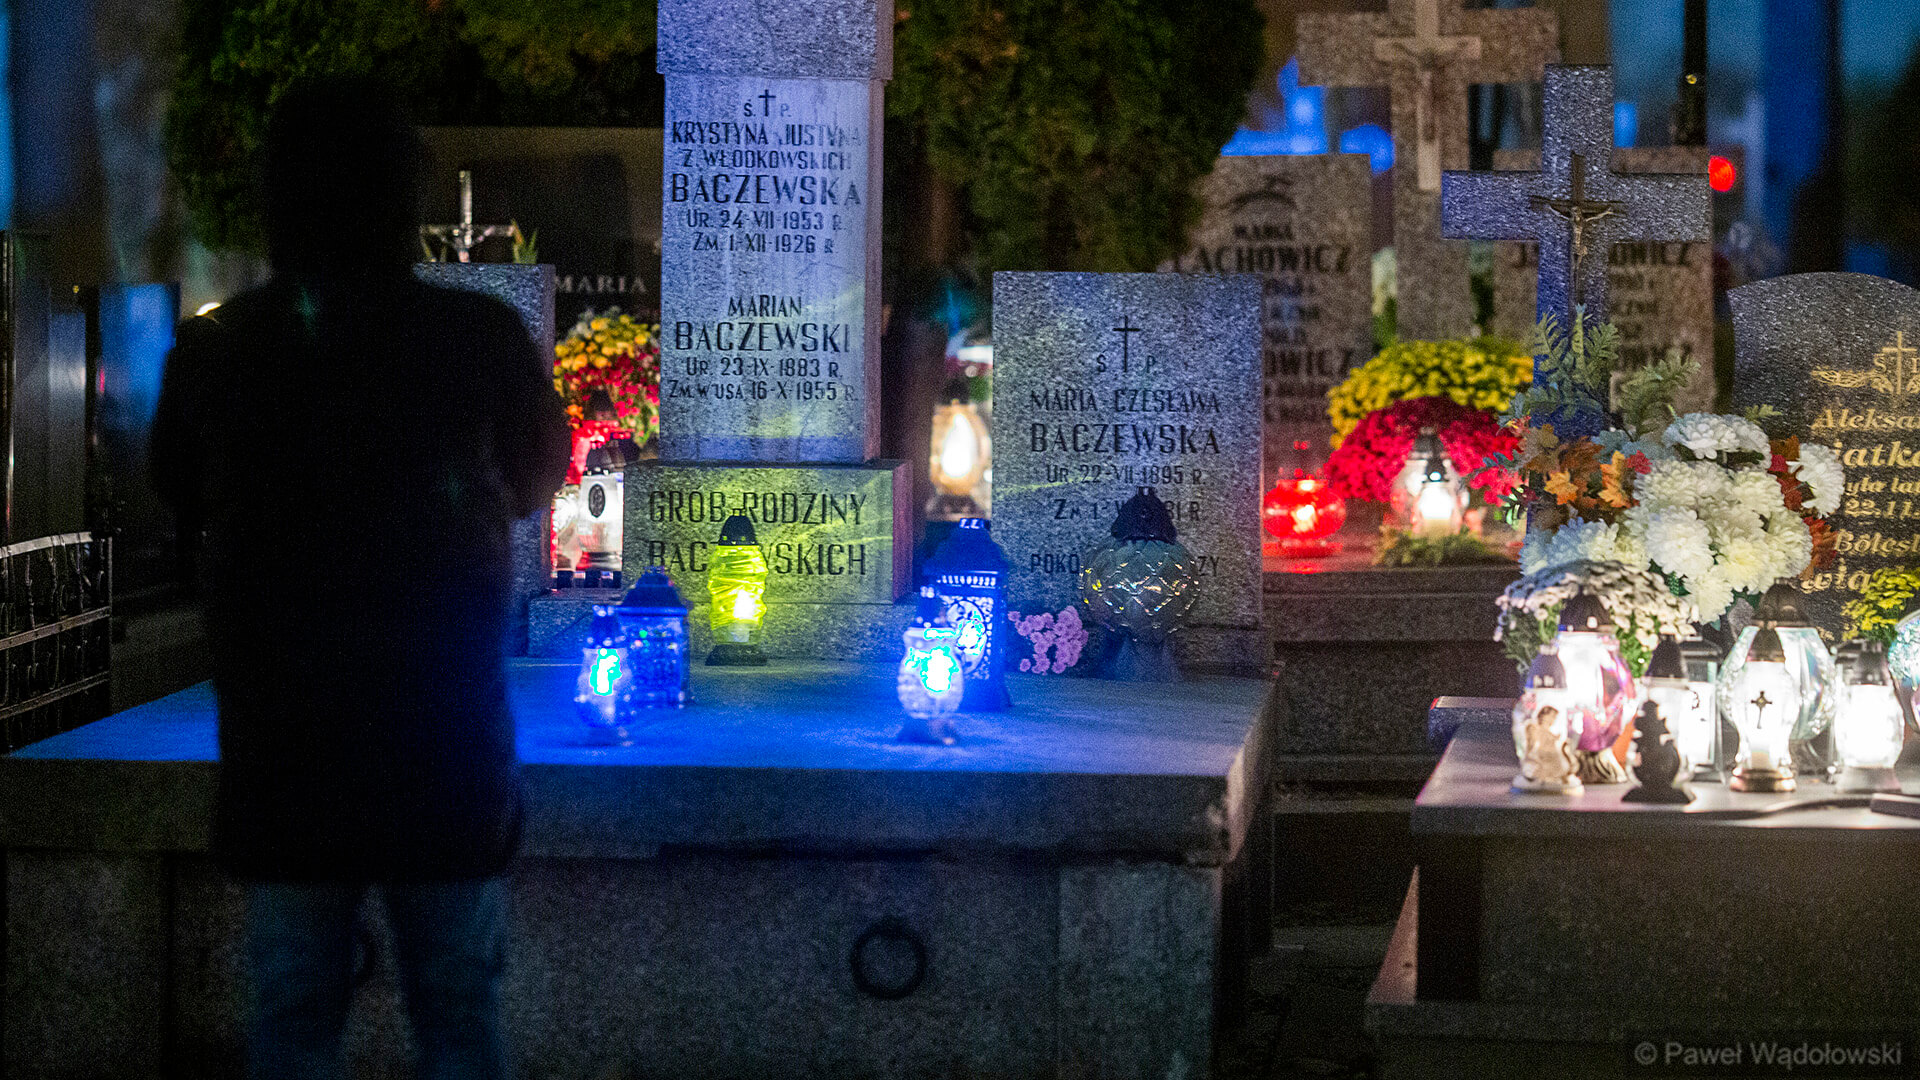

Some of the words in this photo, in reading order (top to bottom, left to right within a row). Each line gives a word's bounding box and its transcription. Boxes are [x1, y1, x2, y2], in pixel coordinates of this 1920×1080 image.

[672, 121, 769, 145] KRYSTYNA
[672, 173, 861, 205] BACZEWSKA
[554, 275, 648, 294] MARIA
[728, 294, 803, 318] MARIAN
[675, 321, 850, 353] BACZEWSKI
[1030, 389, 1098, 413] MARIA
[1114, 389, 1221, 413] CZESŁAWA
[1030, 423, 1221, 454] BACZEWSKA
[743, 492, 867, 525] RODZINY
